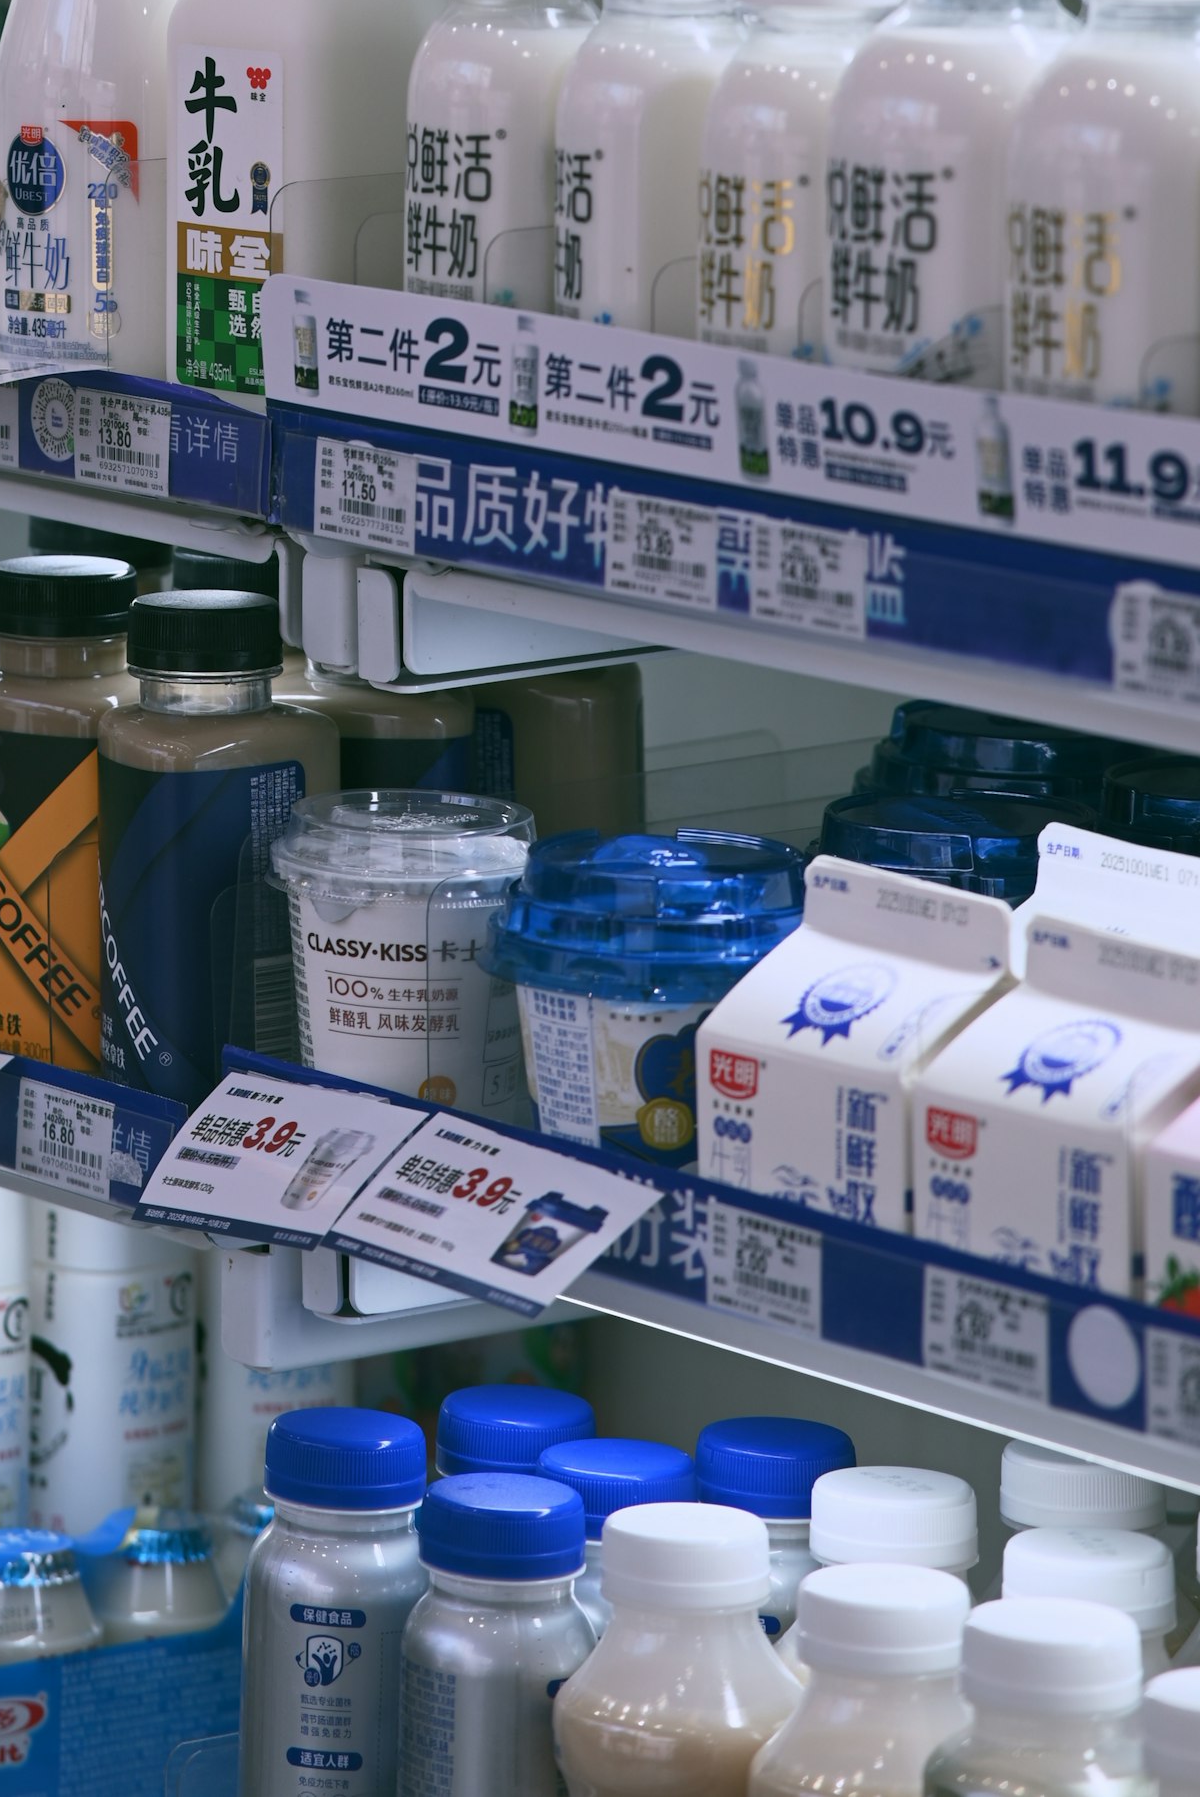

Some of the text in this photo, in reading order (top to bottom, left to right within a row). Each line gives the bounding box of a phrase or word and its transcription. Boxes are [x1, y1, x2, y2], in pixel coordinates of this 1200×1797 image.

[250, 92, 267, 102] 味全
[21, 127, 42, 139] 光明
[184, 57, 240, 217] 牛乳
[9, 150, 58, 188] 优倍
[15, 187, 50, 203] UBEST
[87, 183, 118, 200] 220
[16, 216, 50, 231] 高品质
[5, 231, 70, 291] 鲜牛奶
[185, 227, 272, 281] 味全
[228, 288, 247, 339] 甄选
[7, 315, 67, 340] 净含量:435毫升
[326, 316, 502, 389] 第二件2元
[208, 362, 235, 383] 435mL
[544, 352, 720, 430] 第二件2元
[99, 429, 132, 448] 13.80
[819, 397, 956, 460] 10.9元
[99, 461, 159, 479] 6932571070783
[341, 479, 376, 502] 11.50
[341, 515, 404, 535] 6922577738152
[1047, 842, 1084, 860] 生产日期:
[327, 975, 459, 1003] 100% 生牛乳奶源
[329, 1006, 460, 1033] 鲜酪乳 风味发酵乳
[712, 1053, 757, 1088] 光明
[42, 1122, 75, 1147] 16.80
[190, 1114, 306, 1158] 单品特惠3.9元
[929, 1111, 978, 1147] 光明
[395, 1154, 523, 1216] 单品特惠3.9元
[302, 1608, 353, 1626] 保健食品
[300, 1693, 352, 1709] 甄选专业菌株
[300, 1713, 352, 1728] 调节肠道菌群
[300, 1725, 352, 1739] 增强免疫力
[300, 1751, 350, 1769] 适宜人群
[298, 1775, 350, 1790] 免疫力低下者
